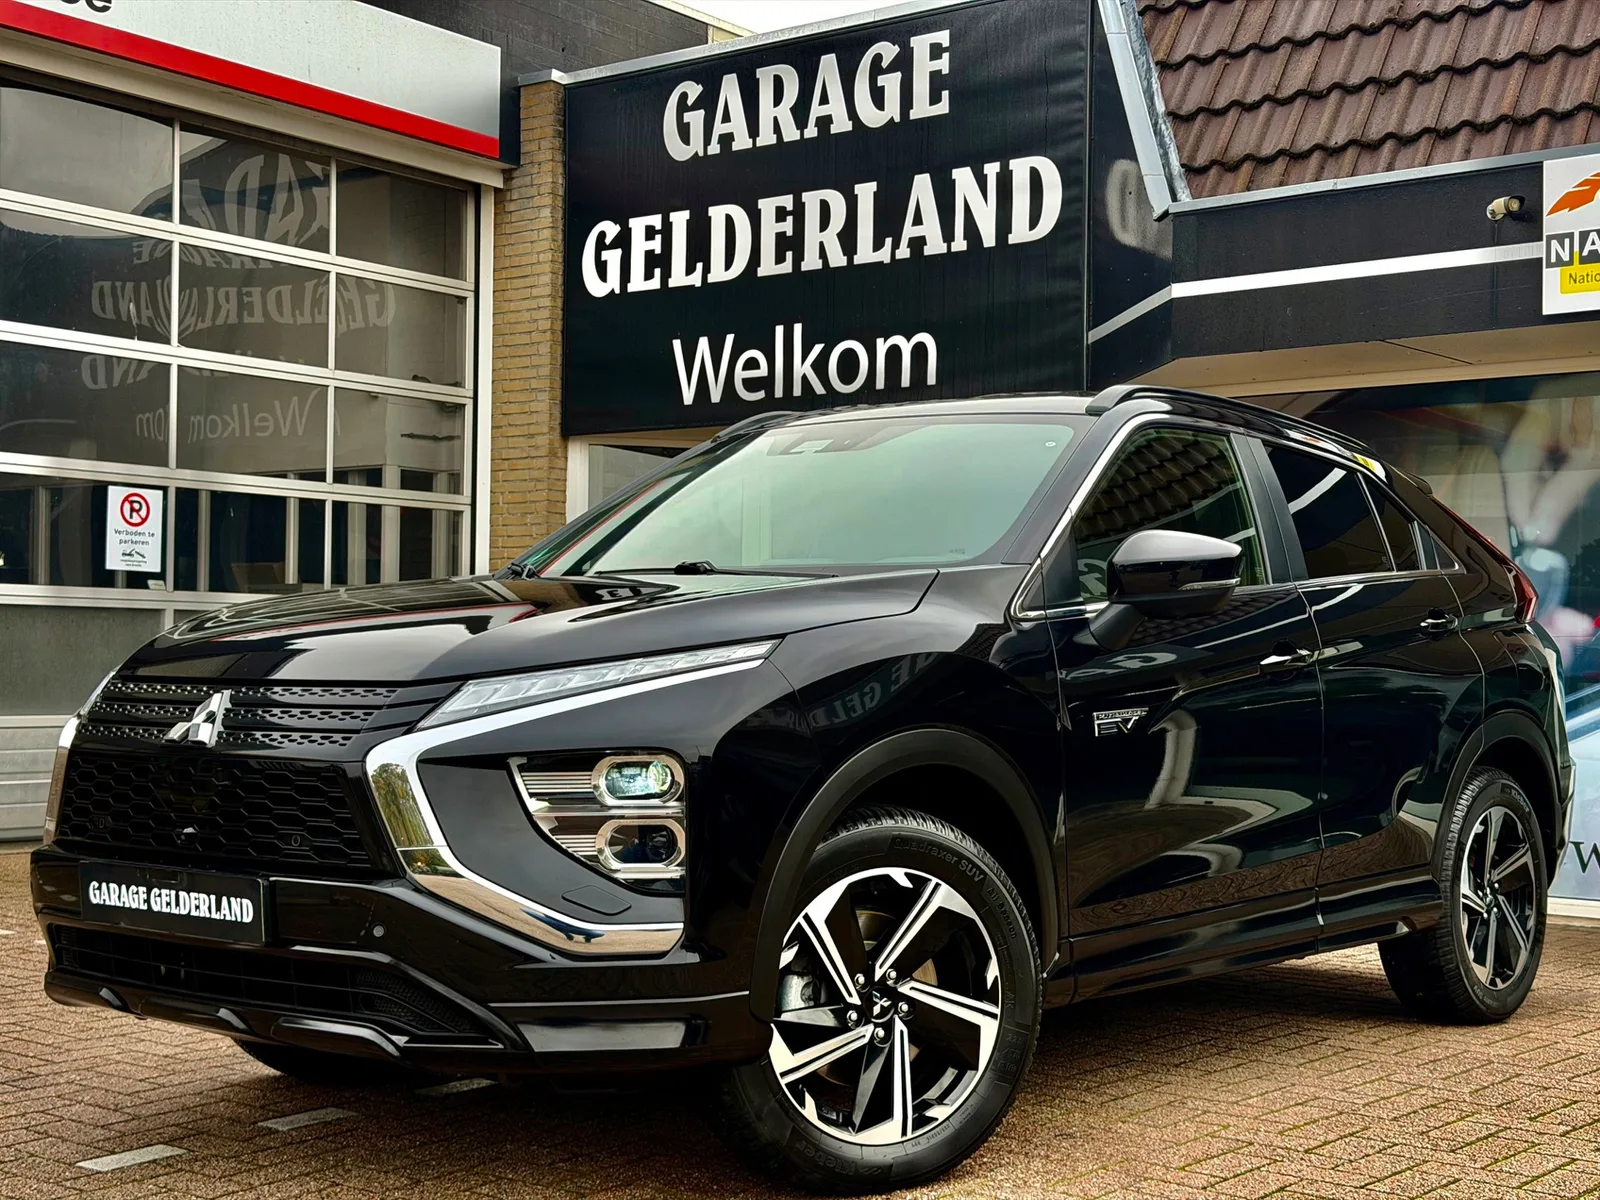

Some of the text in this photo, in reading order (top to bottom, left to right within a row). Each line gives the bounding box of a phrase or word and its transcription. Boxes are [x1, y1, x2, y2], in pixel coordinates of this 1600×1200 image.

[662, 29, 951, 162] GARAGE
[581, 155, 1063, 298] GELDERLAND
[672, 322, 938, 406] Welkom
[114, 528, 146, 537] Verboden
[119, 538, 150, 546] parkeren
[1094, 716, 1139, 737] EV
[958, 859, 985, 883] SUV
[89, 881, 254, 923] GARAGE GELDERLAND
